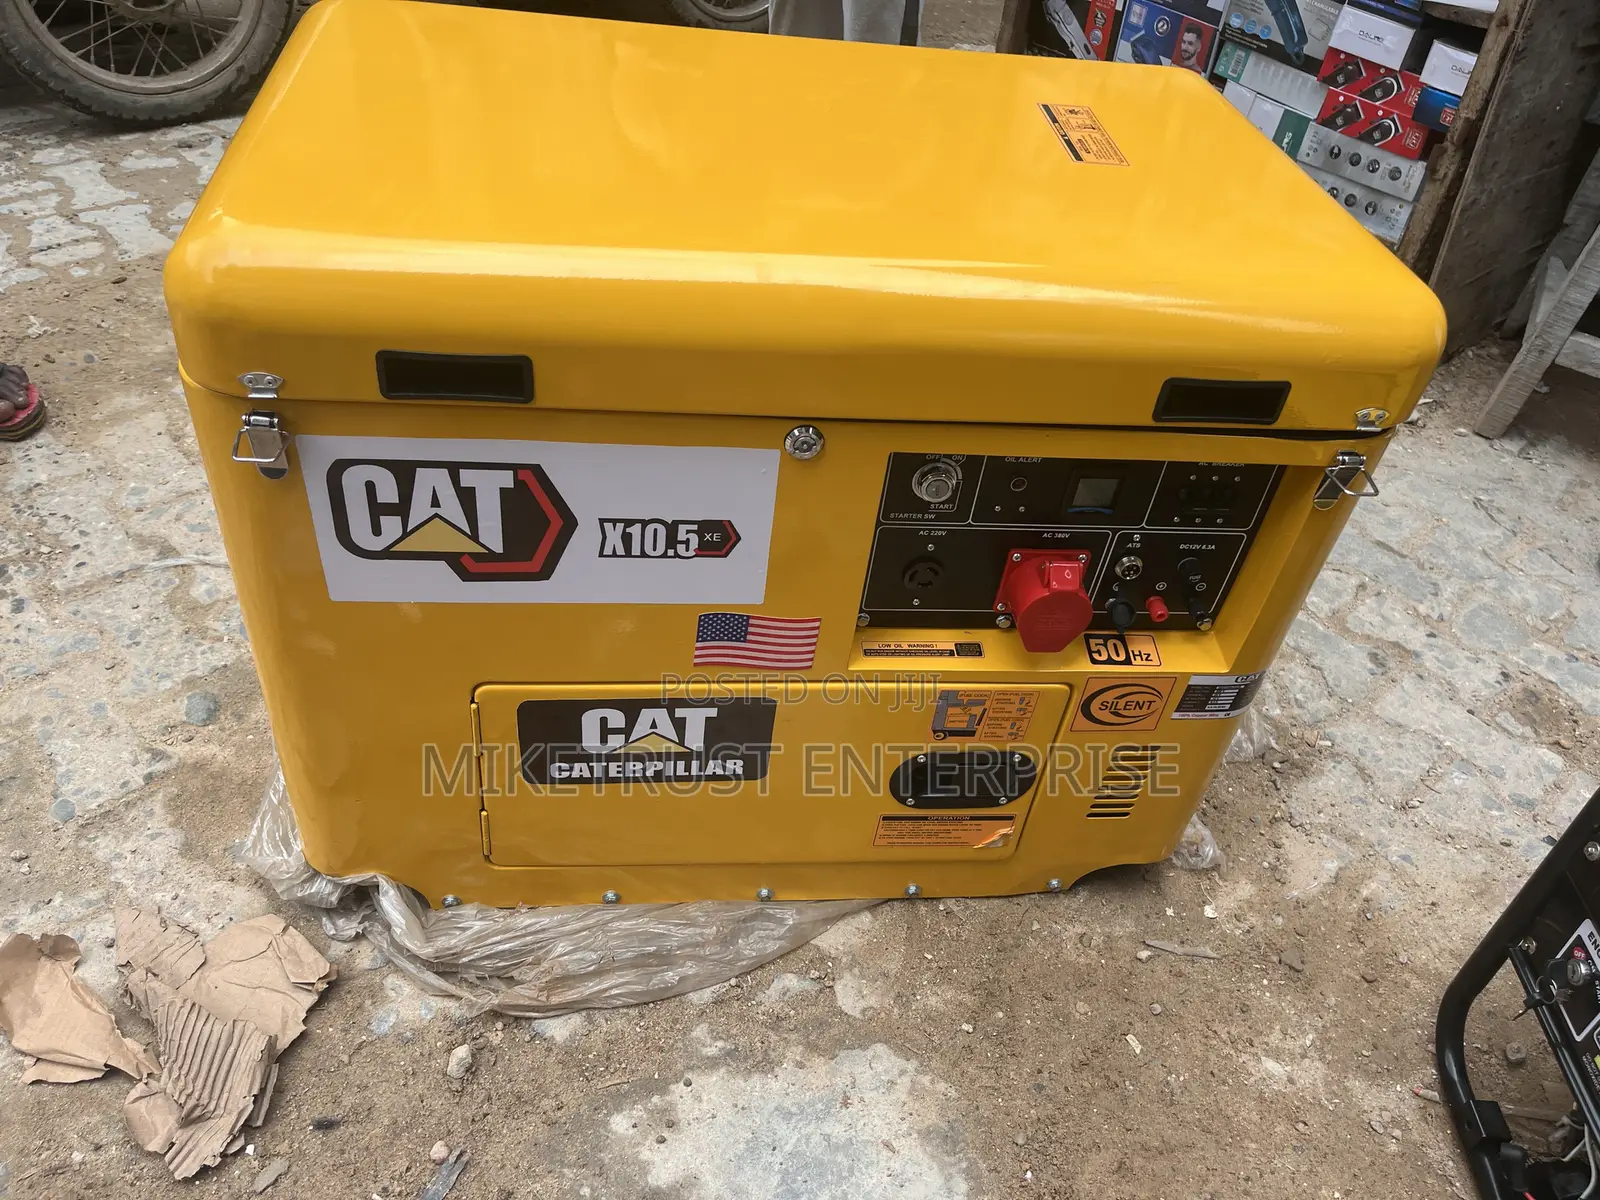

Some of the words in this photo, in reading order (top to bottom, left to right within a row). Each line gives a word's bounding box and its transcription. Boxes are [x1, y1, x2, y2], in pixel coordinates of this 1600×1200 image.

[341, 463, 514, 554] CAT
[602, 522, 699, 557] X10.5
[703, 532, 722, 542] XE
[1088, 638, 1127, 662] 50
[1130, 650, 1153, 662] Hz
[1098, 700, 1157, 711] SILENT
[581, 707, 718, 754] CAT
[550, 759, 744, 779] CATERPILLAR
[1573, 949, 1586, 960] OFF
